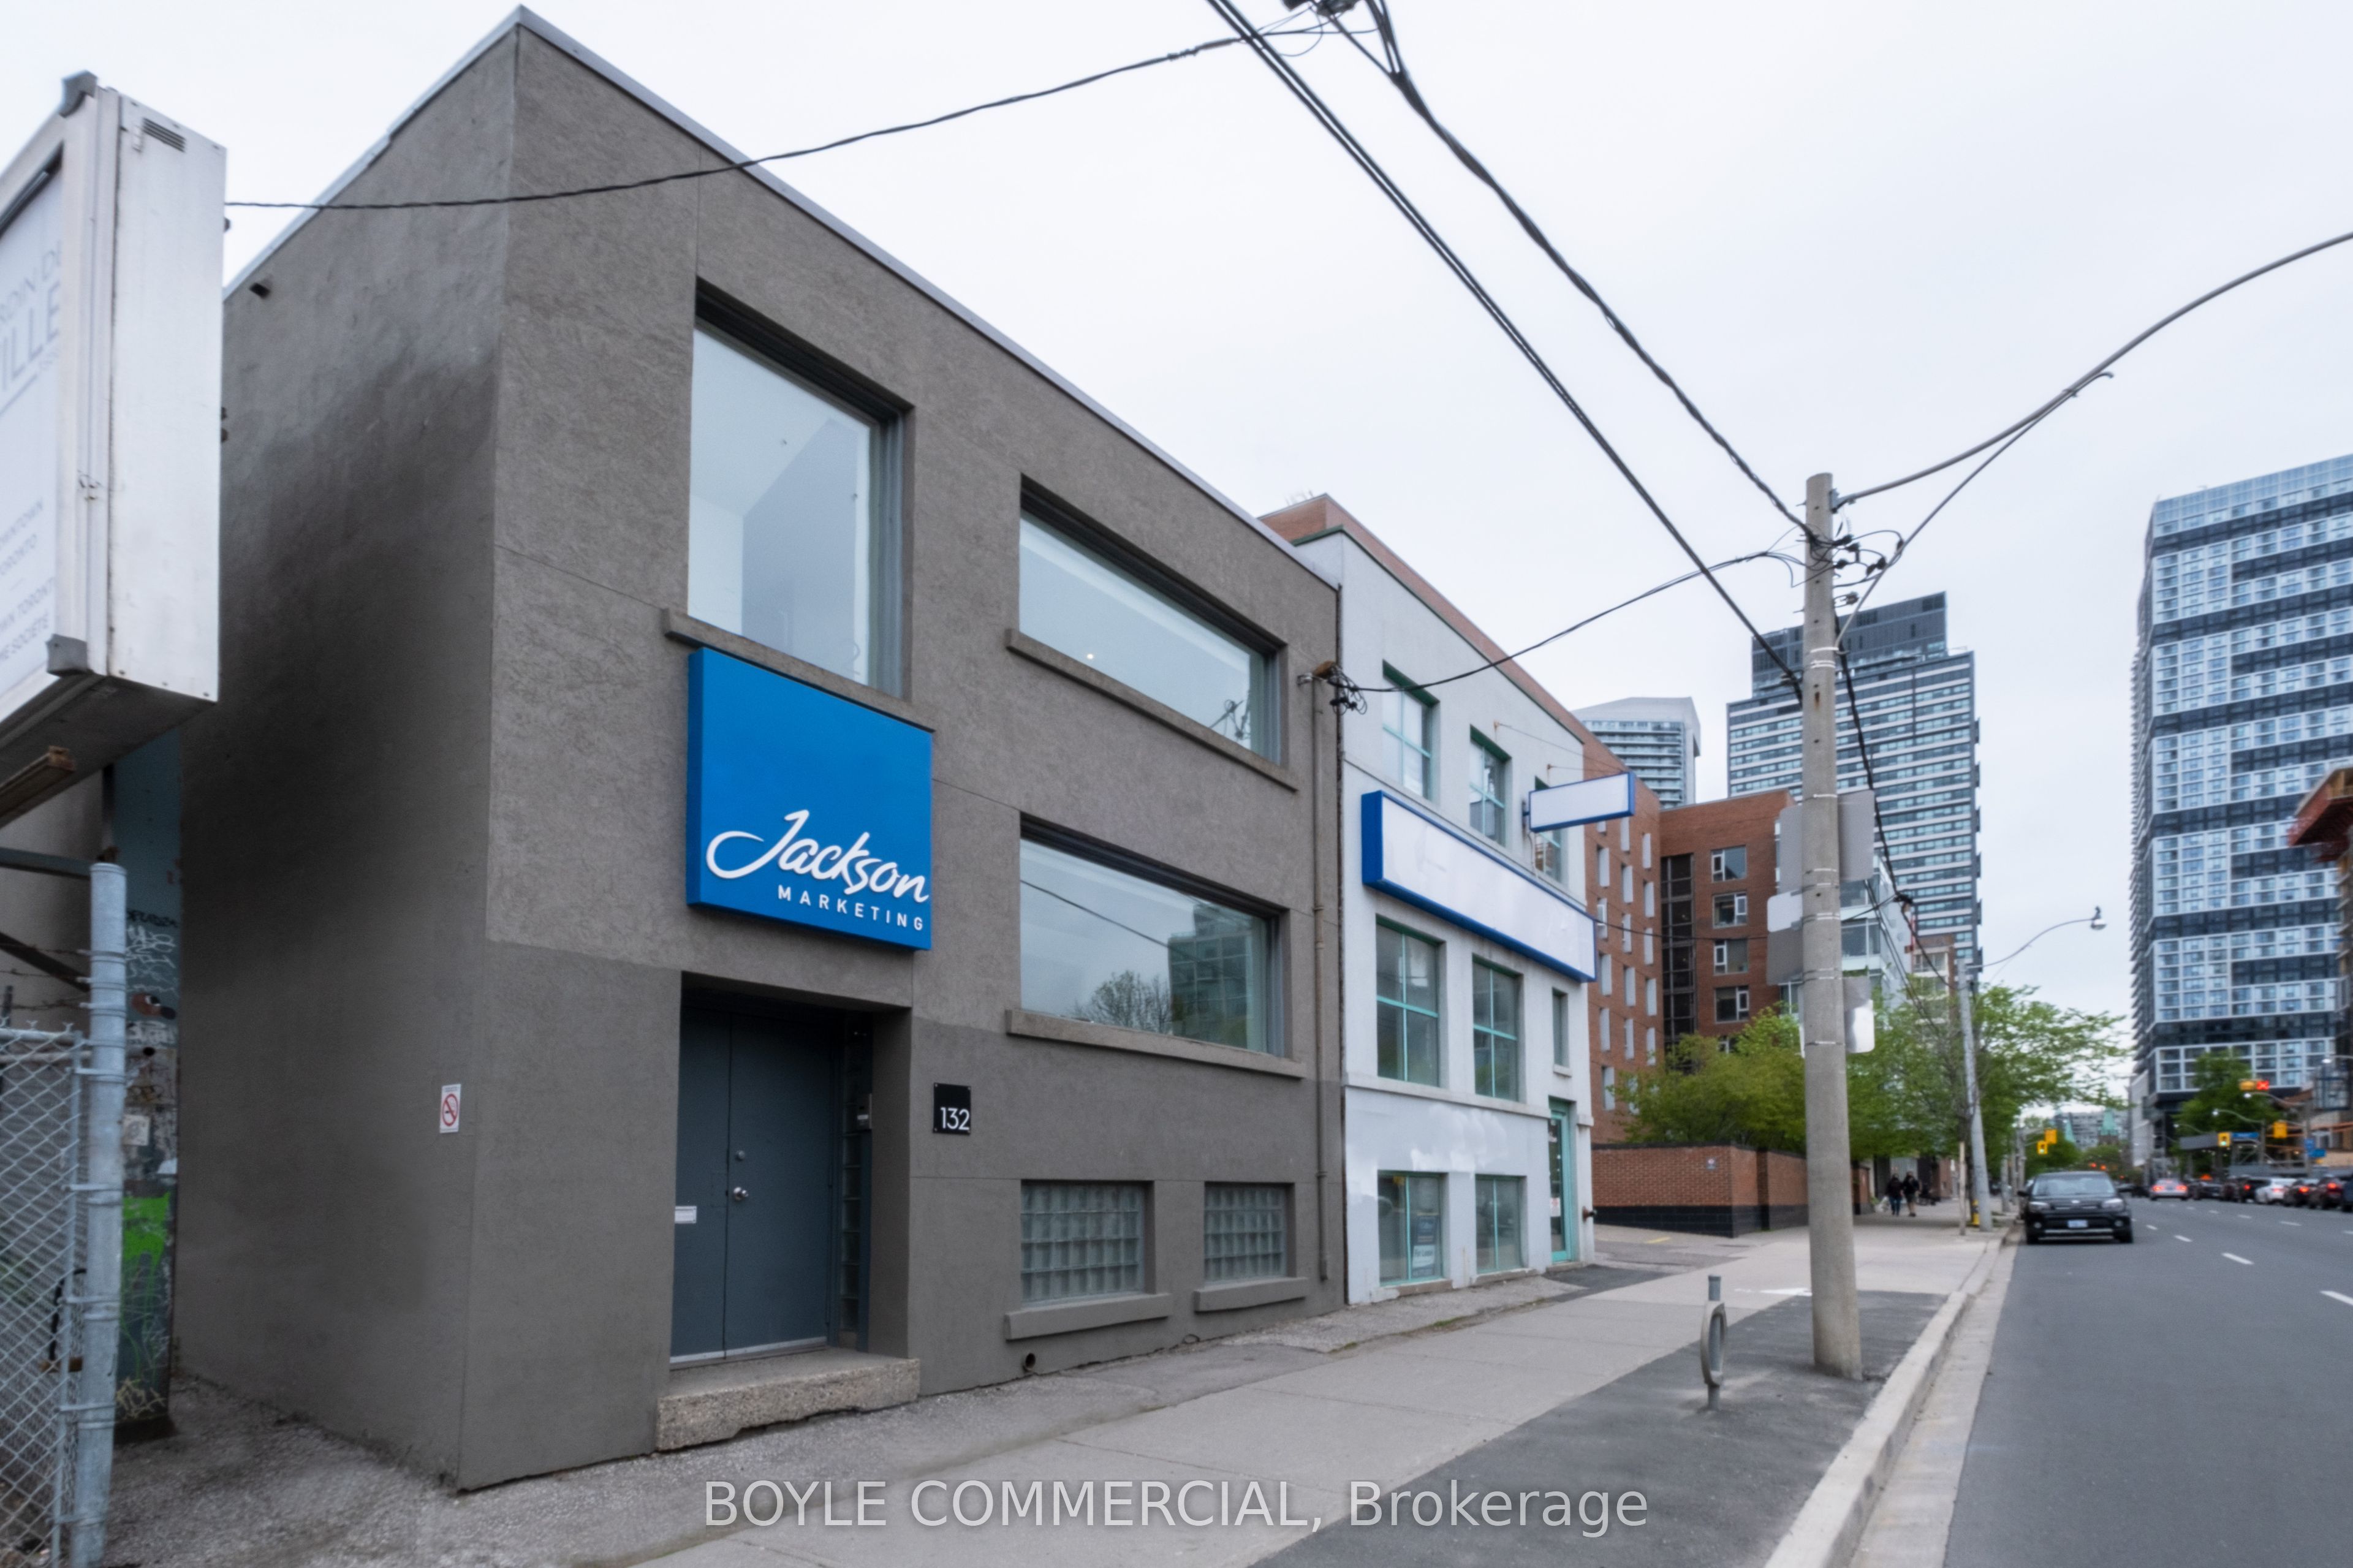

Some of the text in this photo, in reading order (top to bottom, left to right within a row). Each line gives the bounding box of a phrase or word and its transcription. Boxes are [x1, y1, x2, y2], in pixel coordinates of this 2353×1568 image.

[706, 809, 929, 903] Jackson
[778, 885, 923, 931] MARKETING
[940, 1107, 970, 1131] 132
